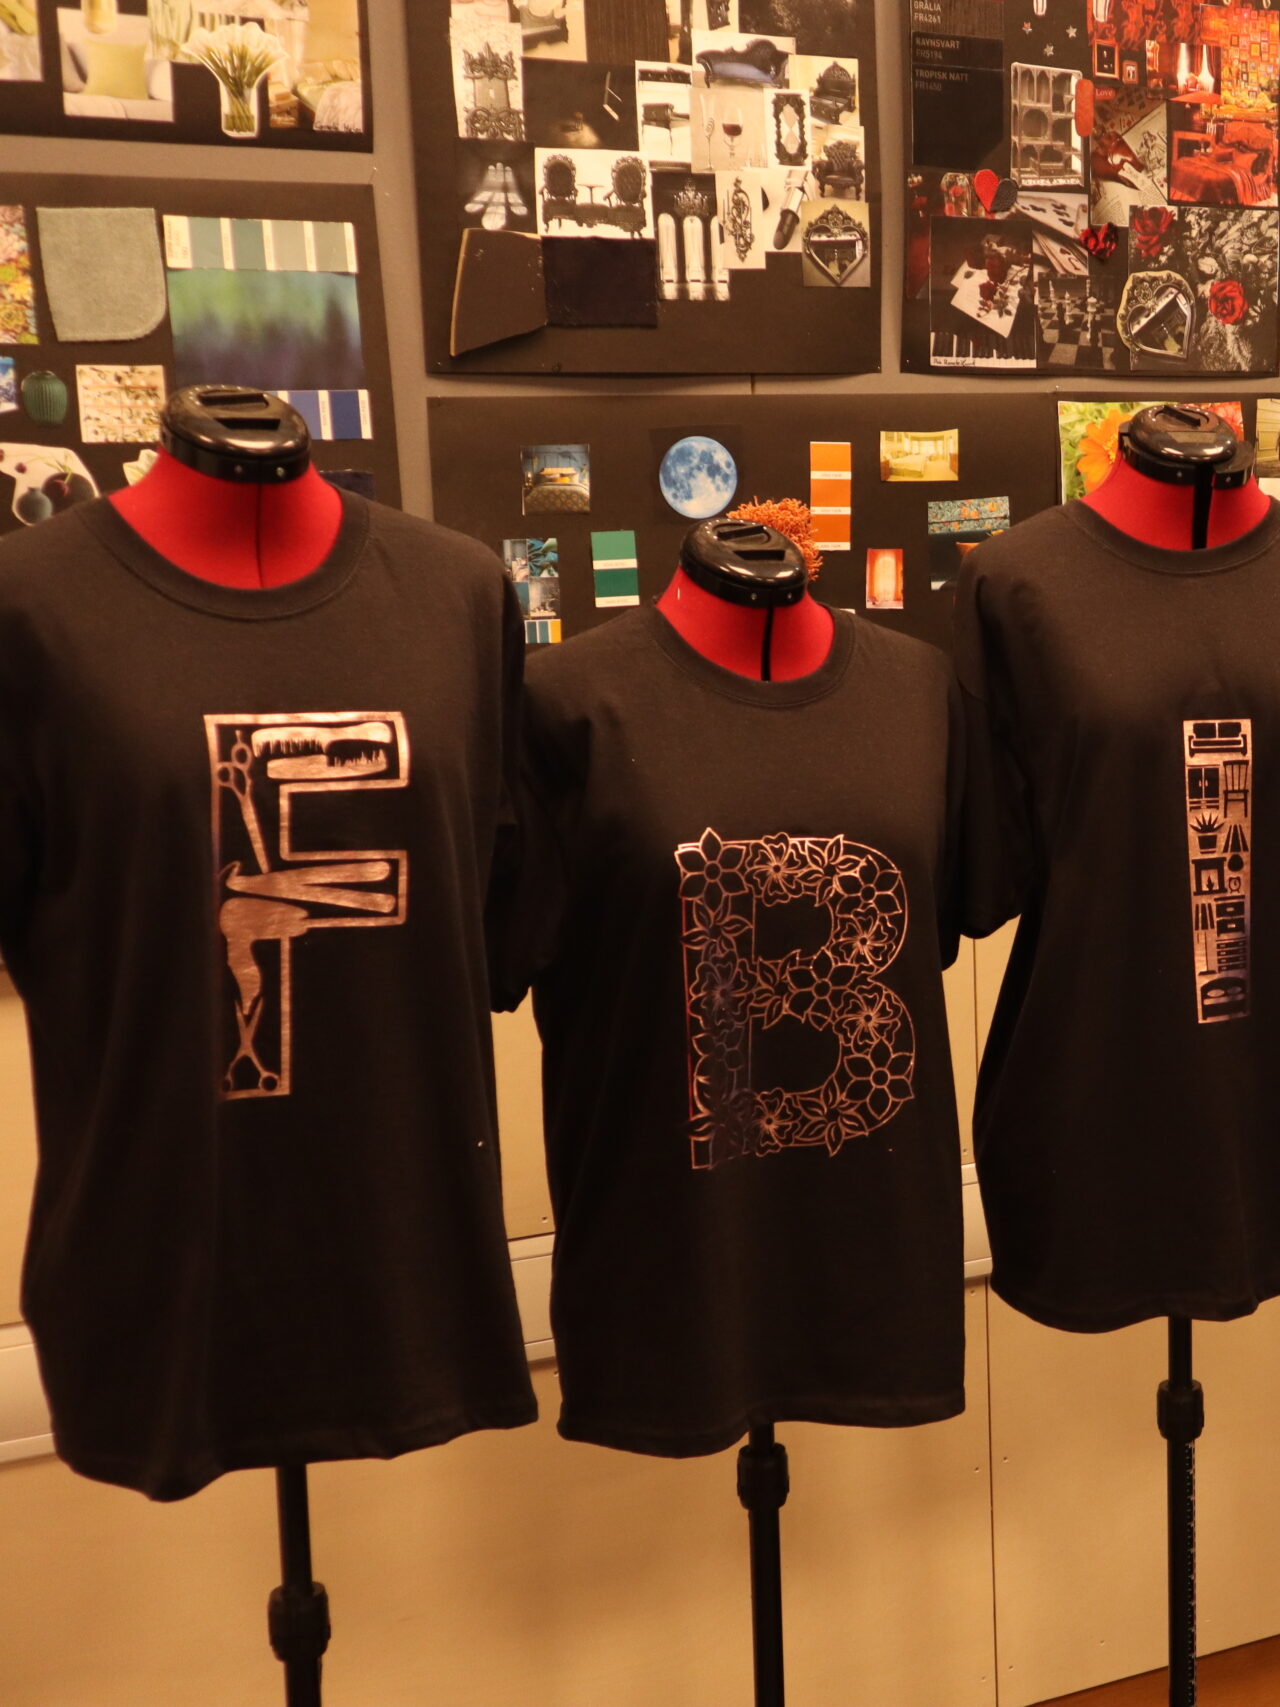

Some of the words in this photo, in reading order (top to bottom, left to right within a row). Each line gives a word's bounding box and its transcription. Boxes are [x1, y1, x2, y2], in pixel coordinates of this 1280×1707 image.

[914, 12, 941, 24] FR4261
[949, 72, 969, 82] NATT
[1095, 88, 1114, 97] Love
